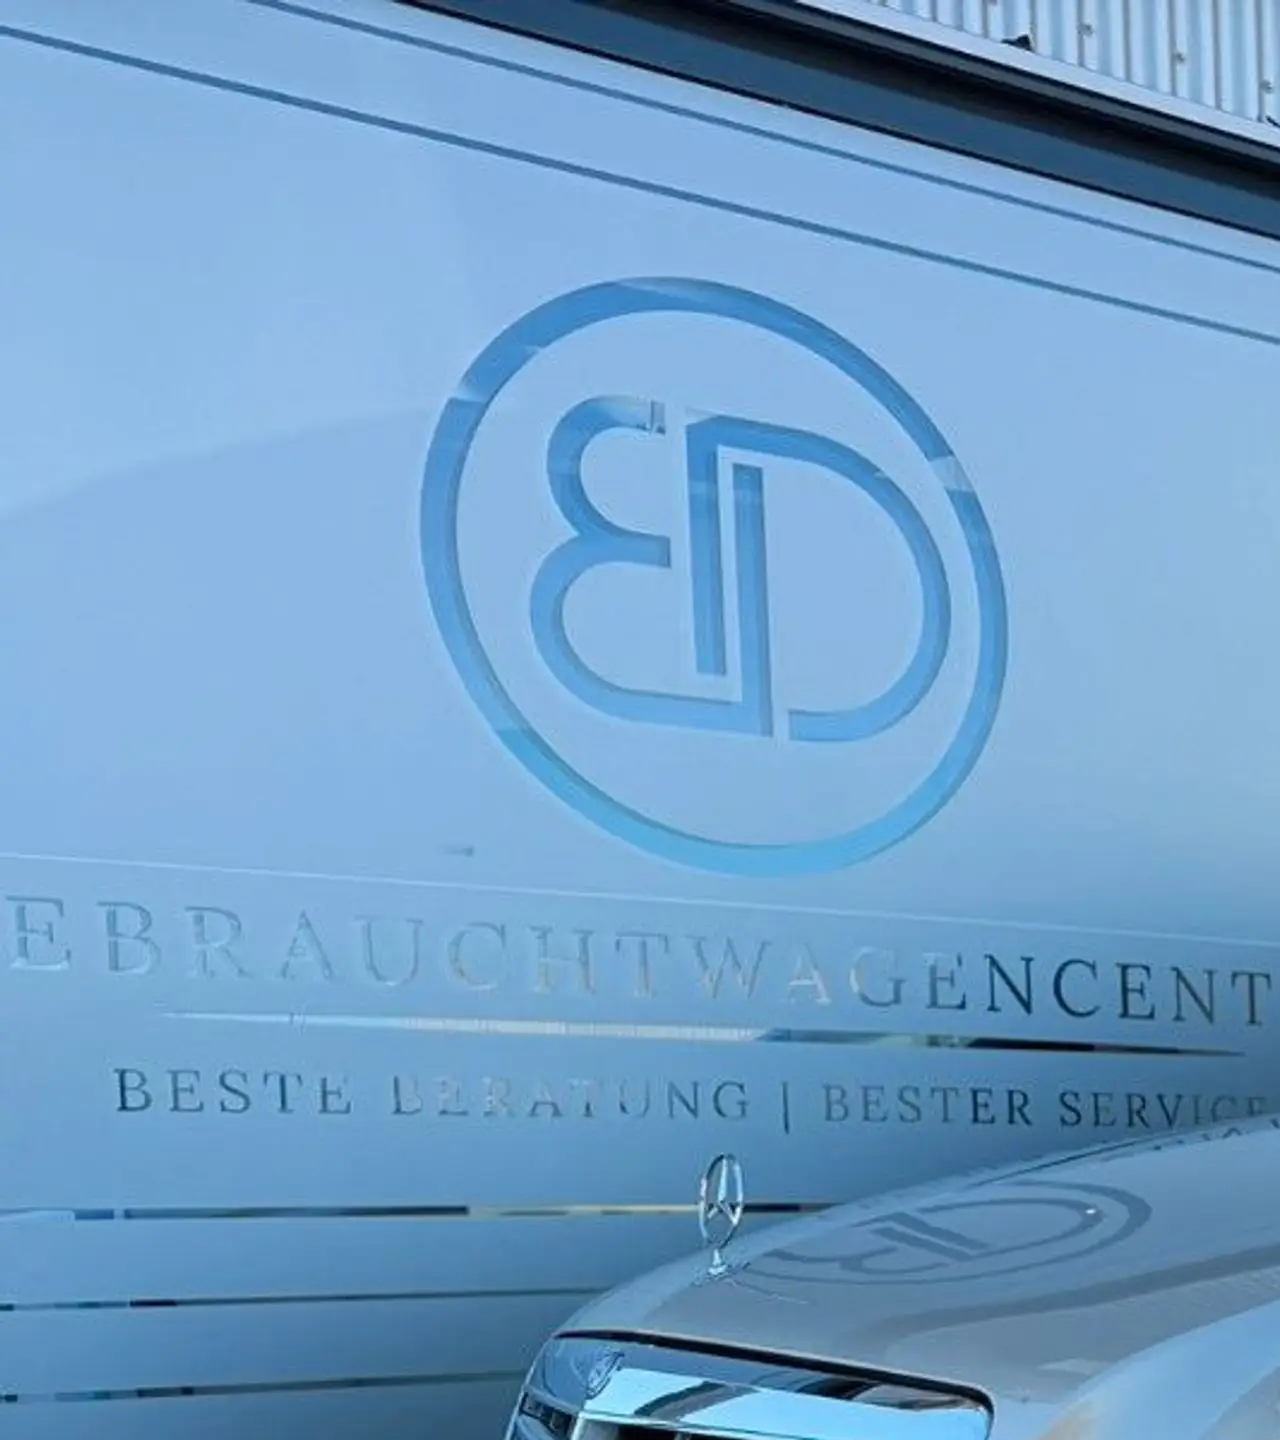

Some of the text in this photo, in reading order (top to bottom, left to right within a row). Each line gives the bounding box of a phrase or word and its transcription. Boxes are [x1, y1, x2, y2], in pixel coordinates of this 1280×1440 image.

[115, 1068, 352, 1114] BESTE
[391, 1074, 749, 1120] BERATUNG
[823, 1083, 1032, 1124] BESTER
